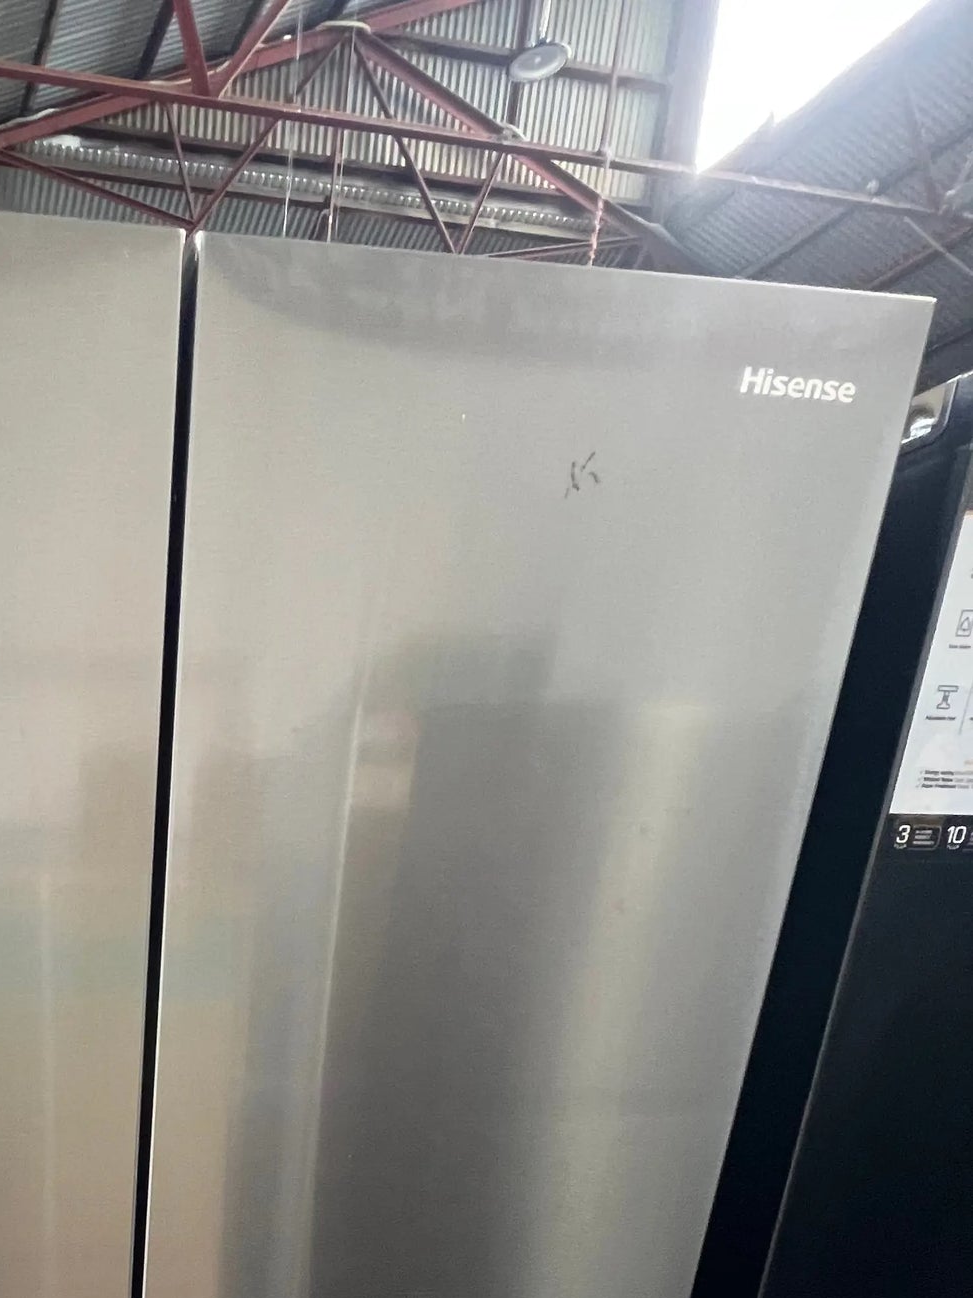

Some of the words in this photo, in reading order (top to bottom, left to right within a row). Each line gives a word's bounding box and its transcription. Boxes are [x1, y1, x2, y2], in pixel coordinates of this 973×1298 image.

[740, 366, 856, 403] Hisense
[896, 824, 911, 844] 3
[947, 825, 967, 844] 10
